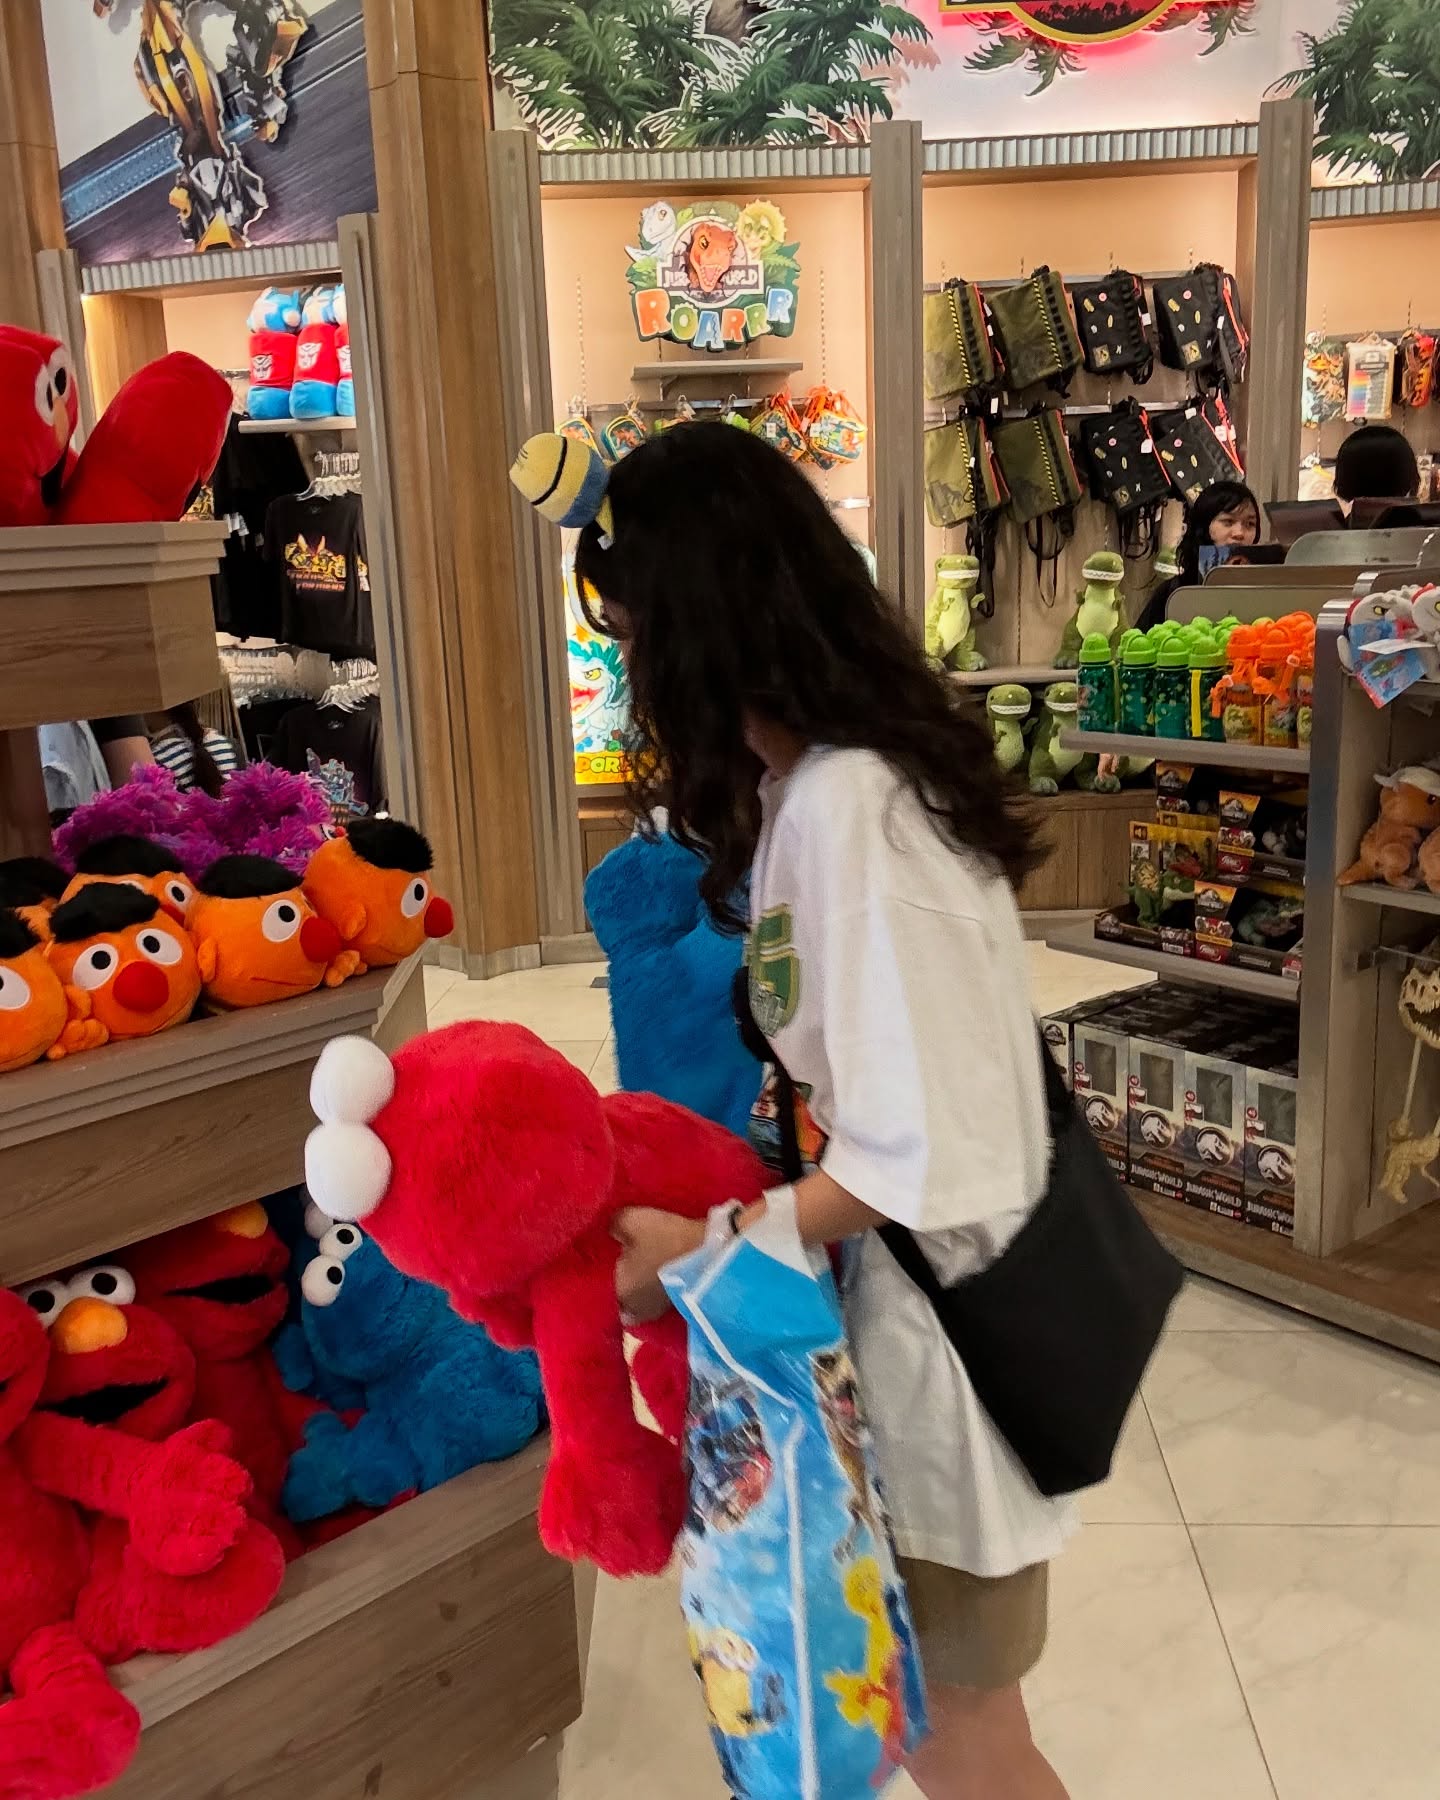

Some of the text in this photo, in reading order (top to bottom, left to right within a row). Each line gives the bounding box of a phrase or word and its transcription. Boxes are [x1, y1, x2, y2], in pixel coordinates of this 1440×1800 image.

[635, 288, 793, 349] ROARRR
[1158, 1172, 1183, 1188] WORLD
[1214, 1190, 1242, 1207] WORLD
